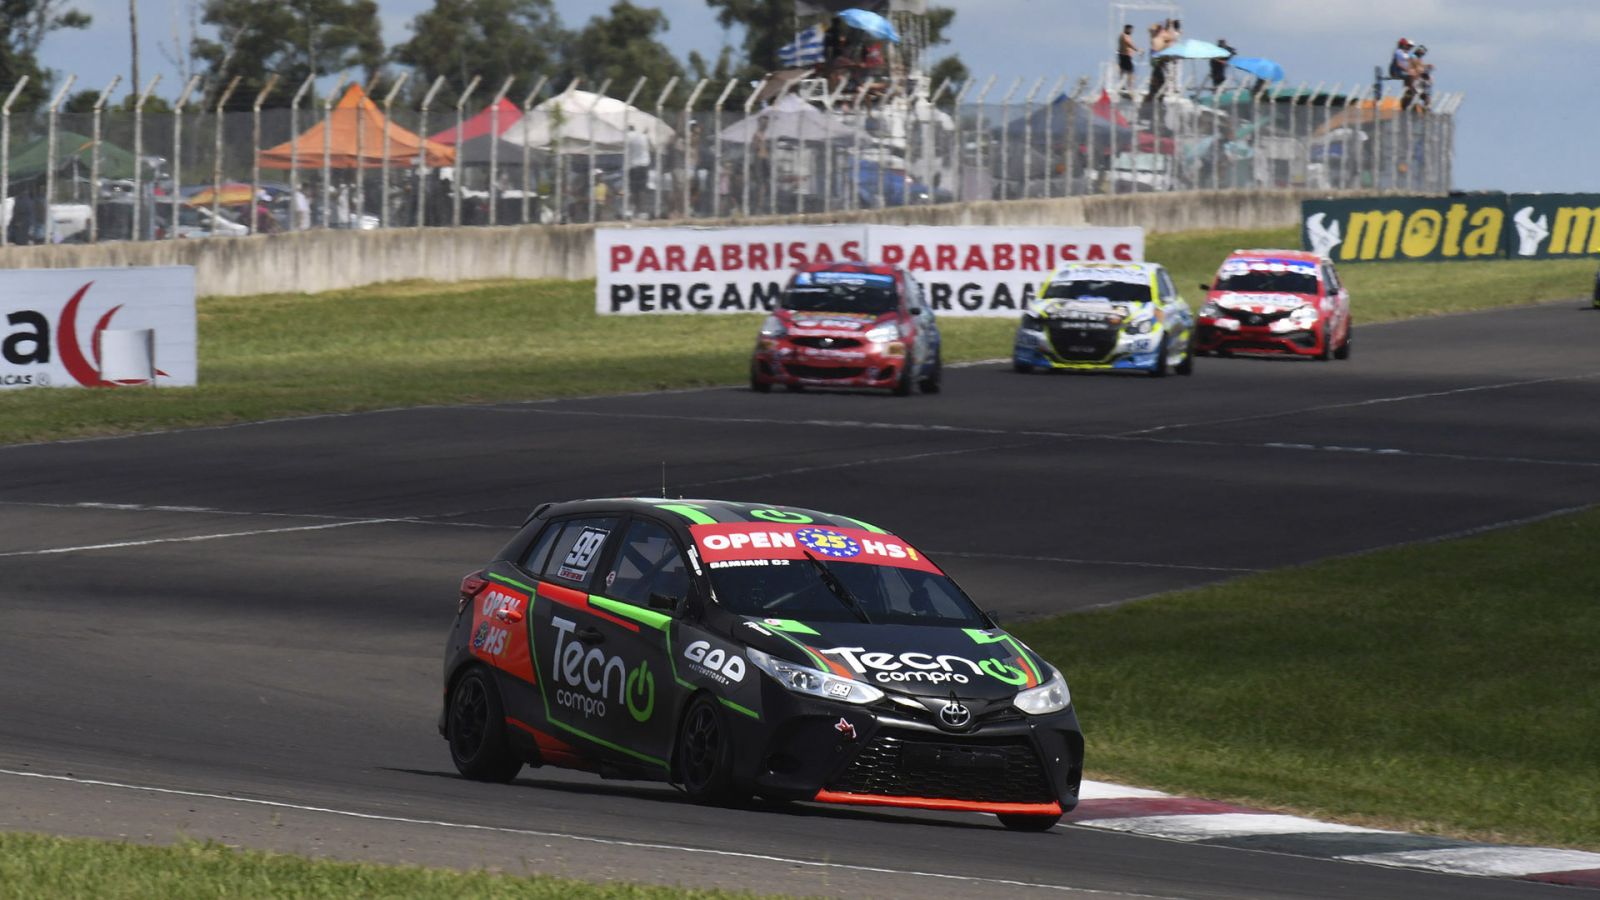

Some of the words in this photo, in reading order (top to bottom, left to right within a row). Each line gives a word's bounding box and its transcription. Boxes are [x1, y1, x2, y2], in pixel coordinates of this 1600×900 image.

[1340, 204, 1504, 260] mota
[610, 241, 863, 272] PARABRISAS
[881, 243, 1132, 272] PARABRISAS
[0, 375, 32, 385] CAS
[564, 531, 606, 568] 99
[703, 532, 797, 550] OPEN
[811, 534, 847, 549] 25
[861, 539, 918, 561] HS!
[710, 559, 769, 569] DAMIANI
[832, 683, 851, 697] 99
[876, 671, 969, 684] compro
[556, 688, 606, 719] compro
